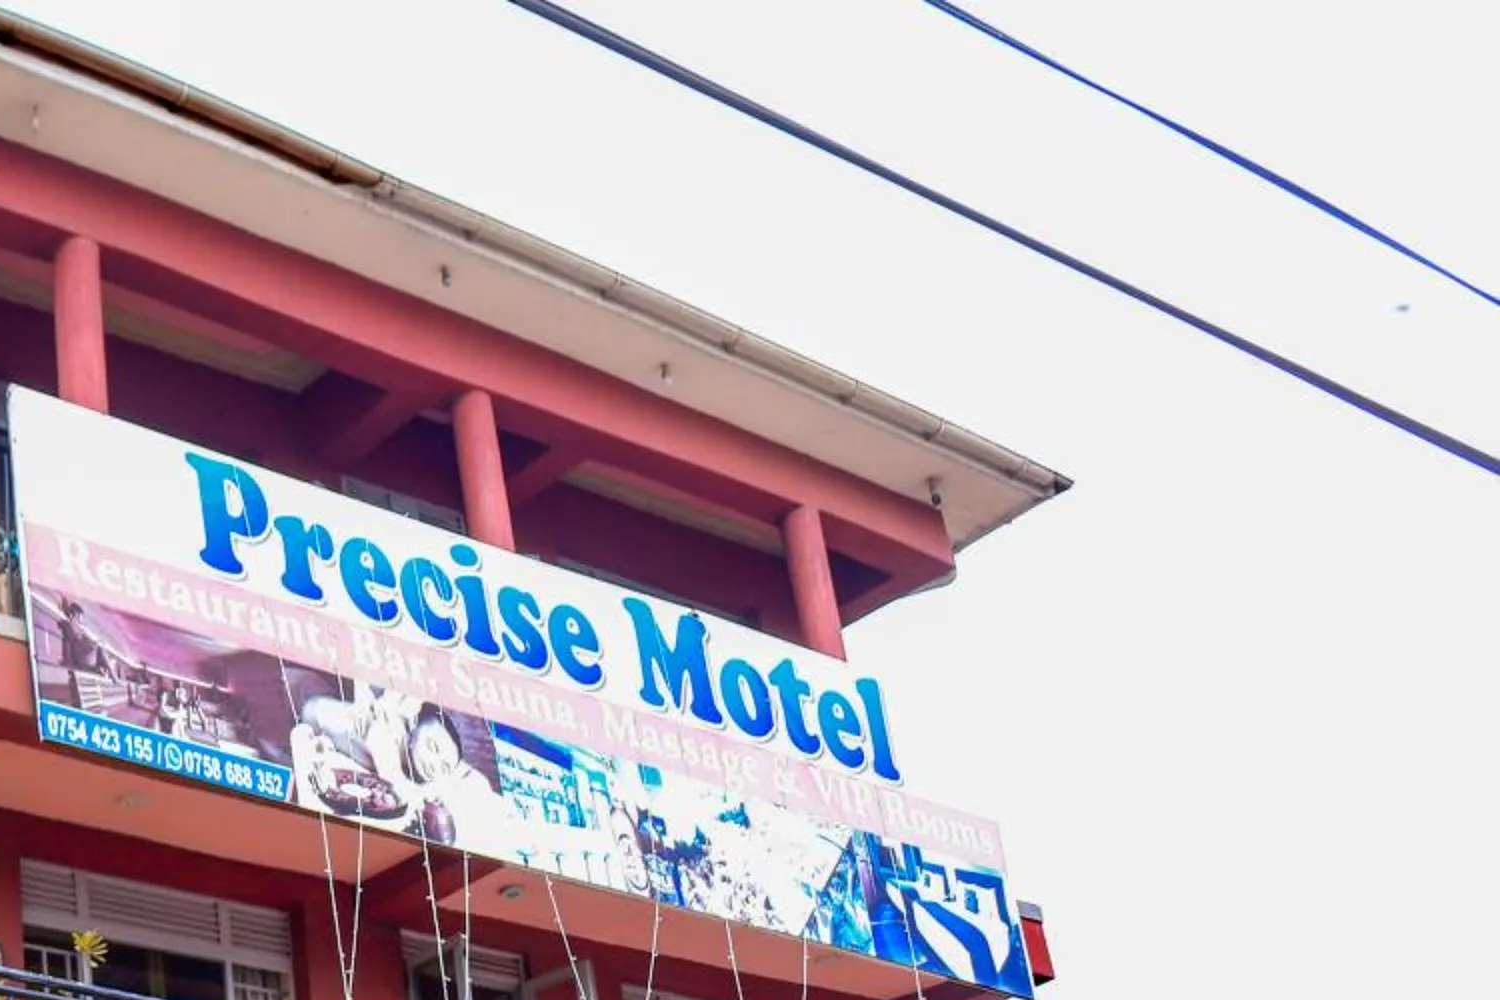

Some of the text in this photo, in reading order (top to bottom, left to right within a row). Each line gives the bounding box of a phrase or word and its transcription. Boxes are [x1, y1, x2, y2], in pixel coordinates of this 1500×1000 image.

[47, 712, 88, 745] 0754
[91, 726, 121, 753] 423
[125, 735, 153, 762] 155
[184, 749, 222, 781] 0758
[224, 761, 253, 789] 688
[256, 769, 285, 797] 352
[56, 535, 995, 855] Restaurant, Bar, Sauna, Massage & VIP Rooms
[185, 452, 900, 782] Precise Motel
